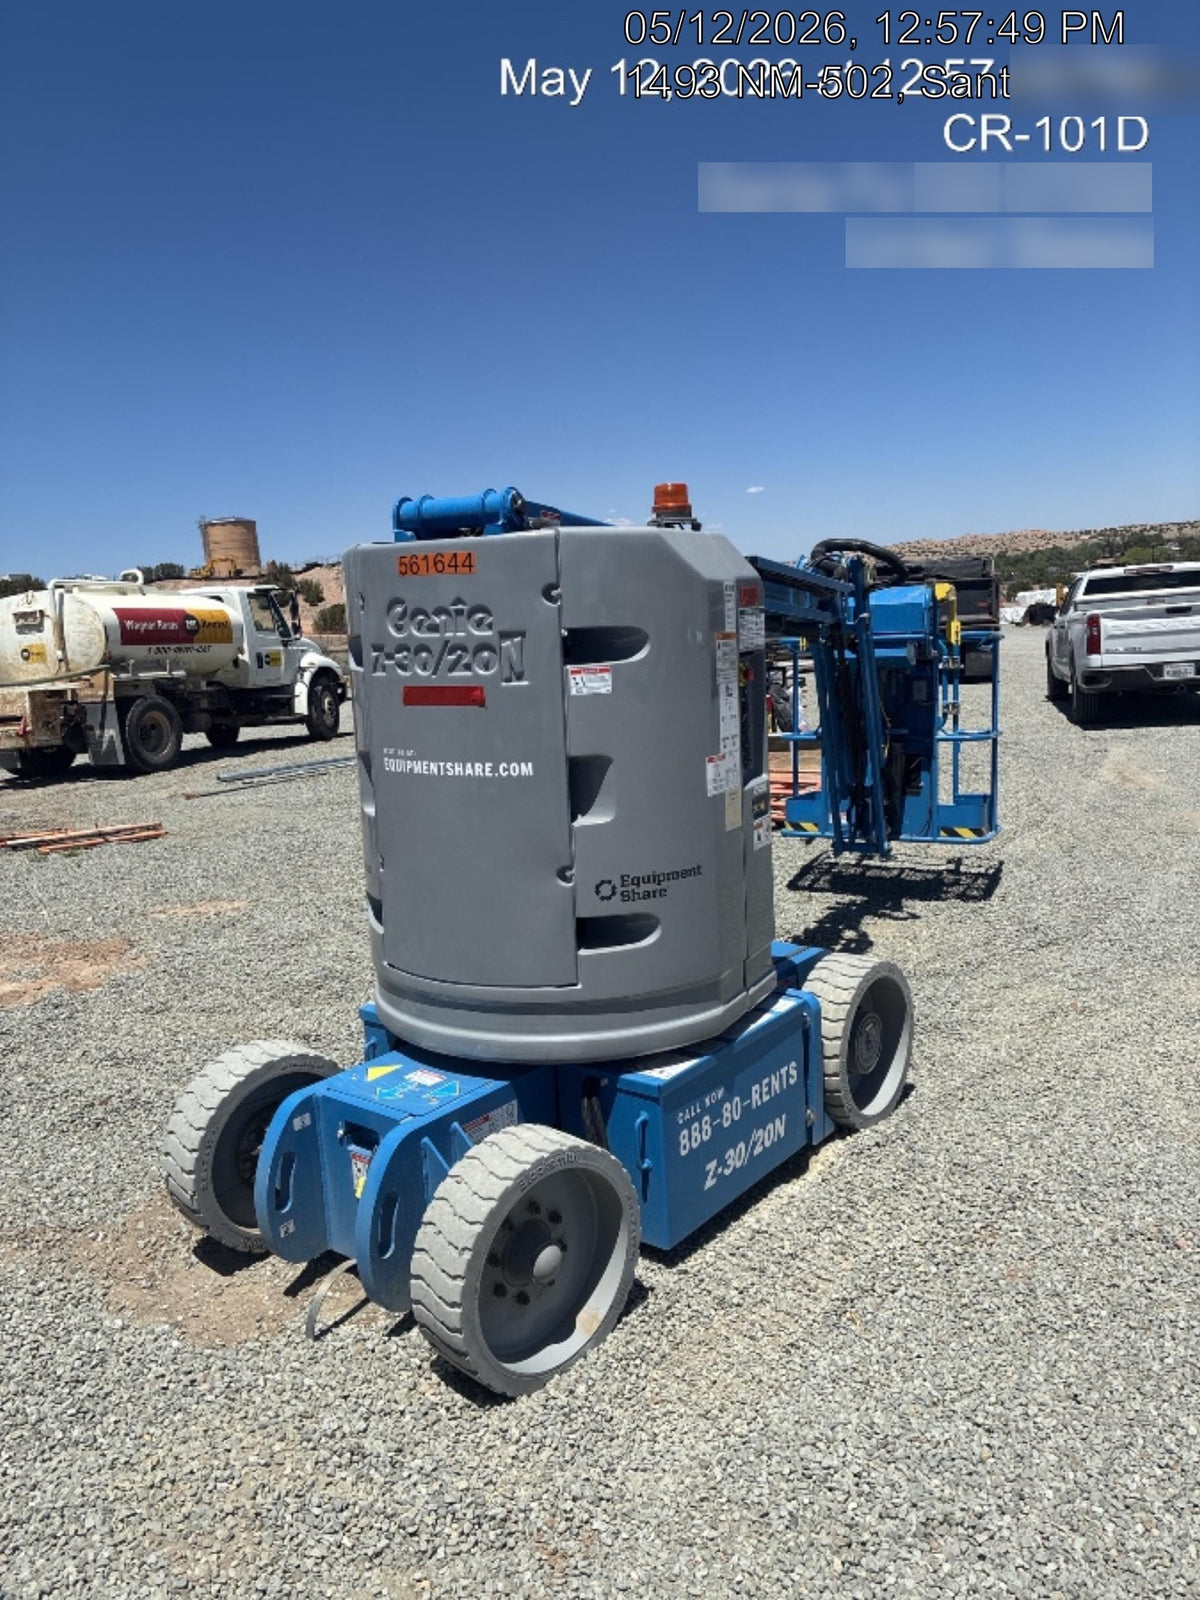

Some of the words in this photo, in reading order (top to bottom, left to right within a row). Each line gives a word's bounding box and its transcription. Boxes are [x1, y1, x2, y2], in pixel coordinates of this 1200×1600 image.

[399, 552, 474, 576] 561644
[387, 597, 493, 637] Genie
[383, 757, 534, 777] EQUIPMENTSHARE.COM
[620, 864, 702, 888] Equipment
[620, 888, 668, 902] Share
[677, 1104, 702, 1125] CALL
[705, 1085, 725, 1108] NOW
[679, 1061, 798, 1157] 888-80-RENTS
[704, 1112, 787, 1191] Z-30/20N
